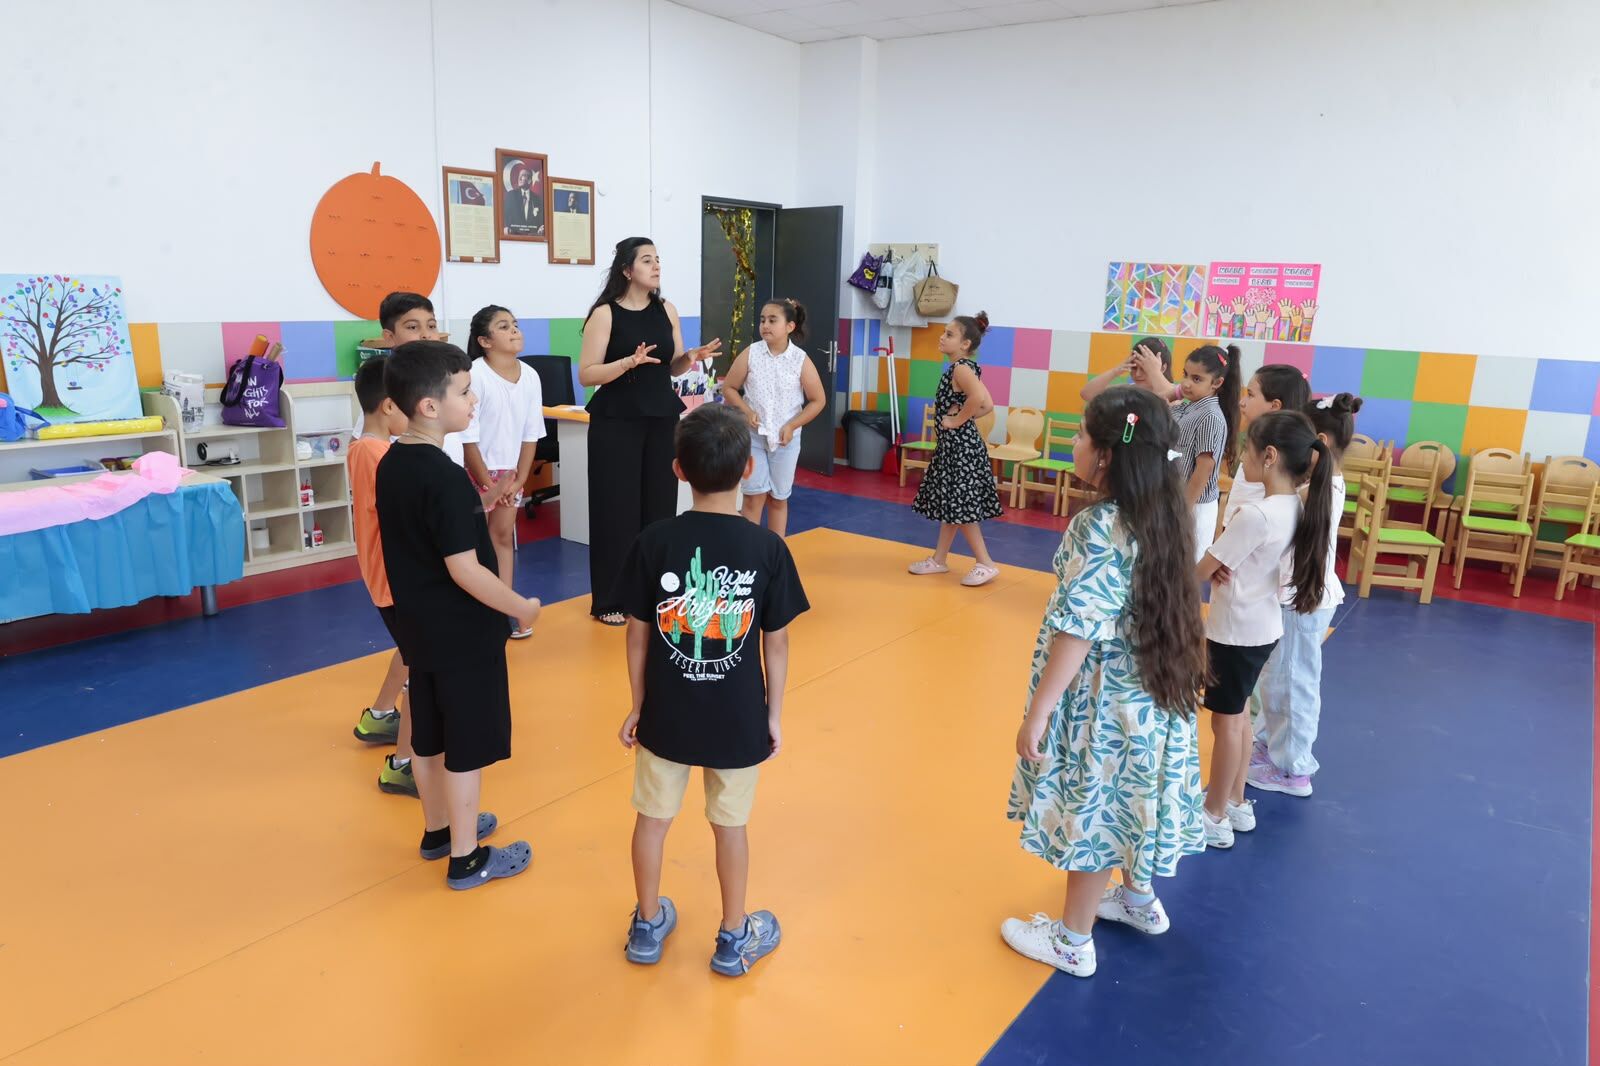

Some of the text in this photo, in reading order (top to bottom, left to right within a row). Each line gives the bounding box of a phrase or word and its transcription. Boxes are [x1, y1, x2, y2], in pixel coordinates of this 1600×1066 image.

[243, 385, 268, 398] GHTS
[247, 397, 269, 409] FOR
[712, 565, 757, 585] Wild
[656, 587, 755, 628] Arizona
[669, 651, 742, 673] DESERT VIBES
